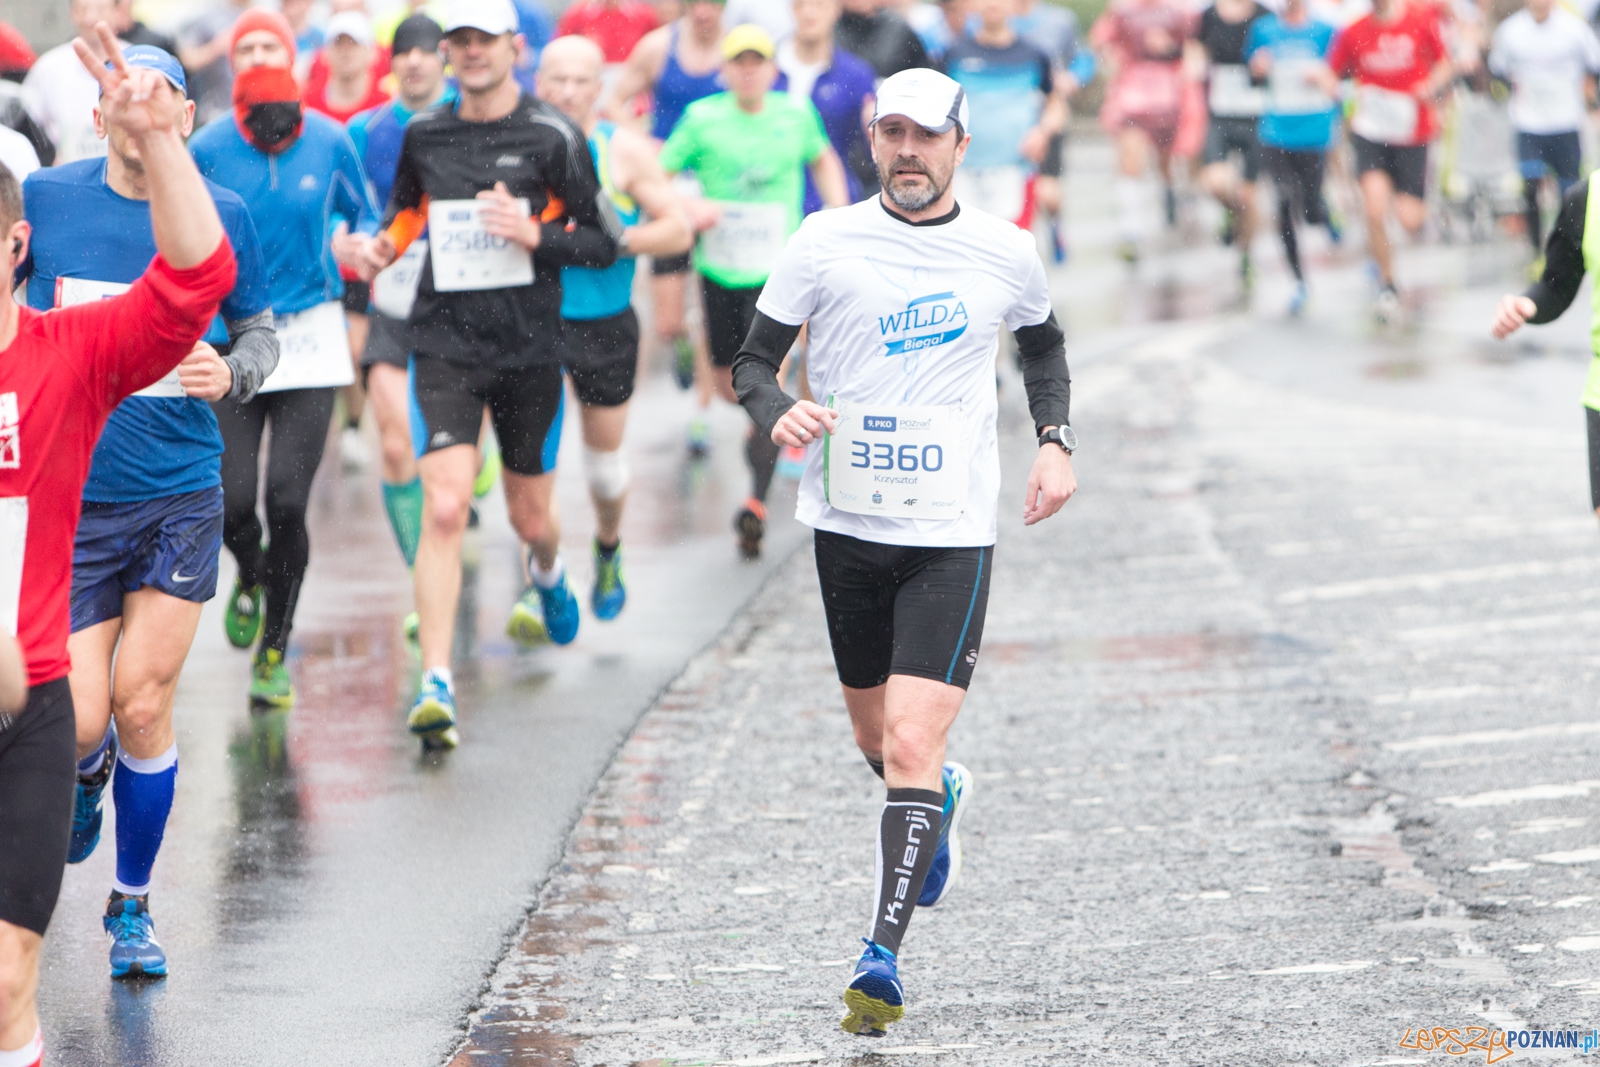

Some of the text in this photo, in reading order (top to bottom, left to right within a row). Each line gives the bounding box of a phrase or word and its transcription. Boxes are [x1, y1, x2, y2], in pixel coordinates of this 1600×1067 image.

[878, 301, 968, 335] WILDA
[903, 333, 945, 350] Biega!
[851, 440, 943, 472] 3360
[874, 474, 918, 485] Krzysztof
[903, 498, 918, 506] 4F
